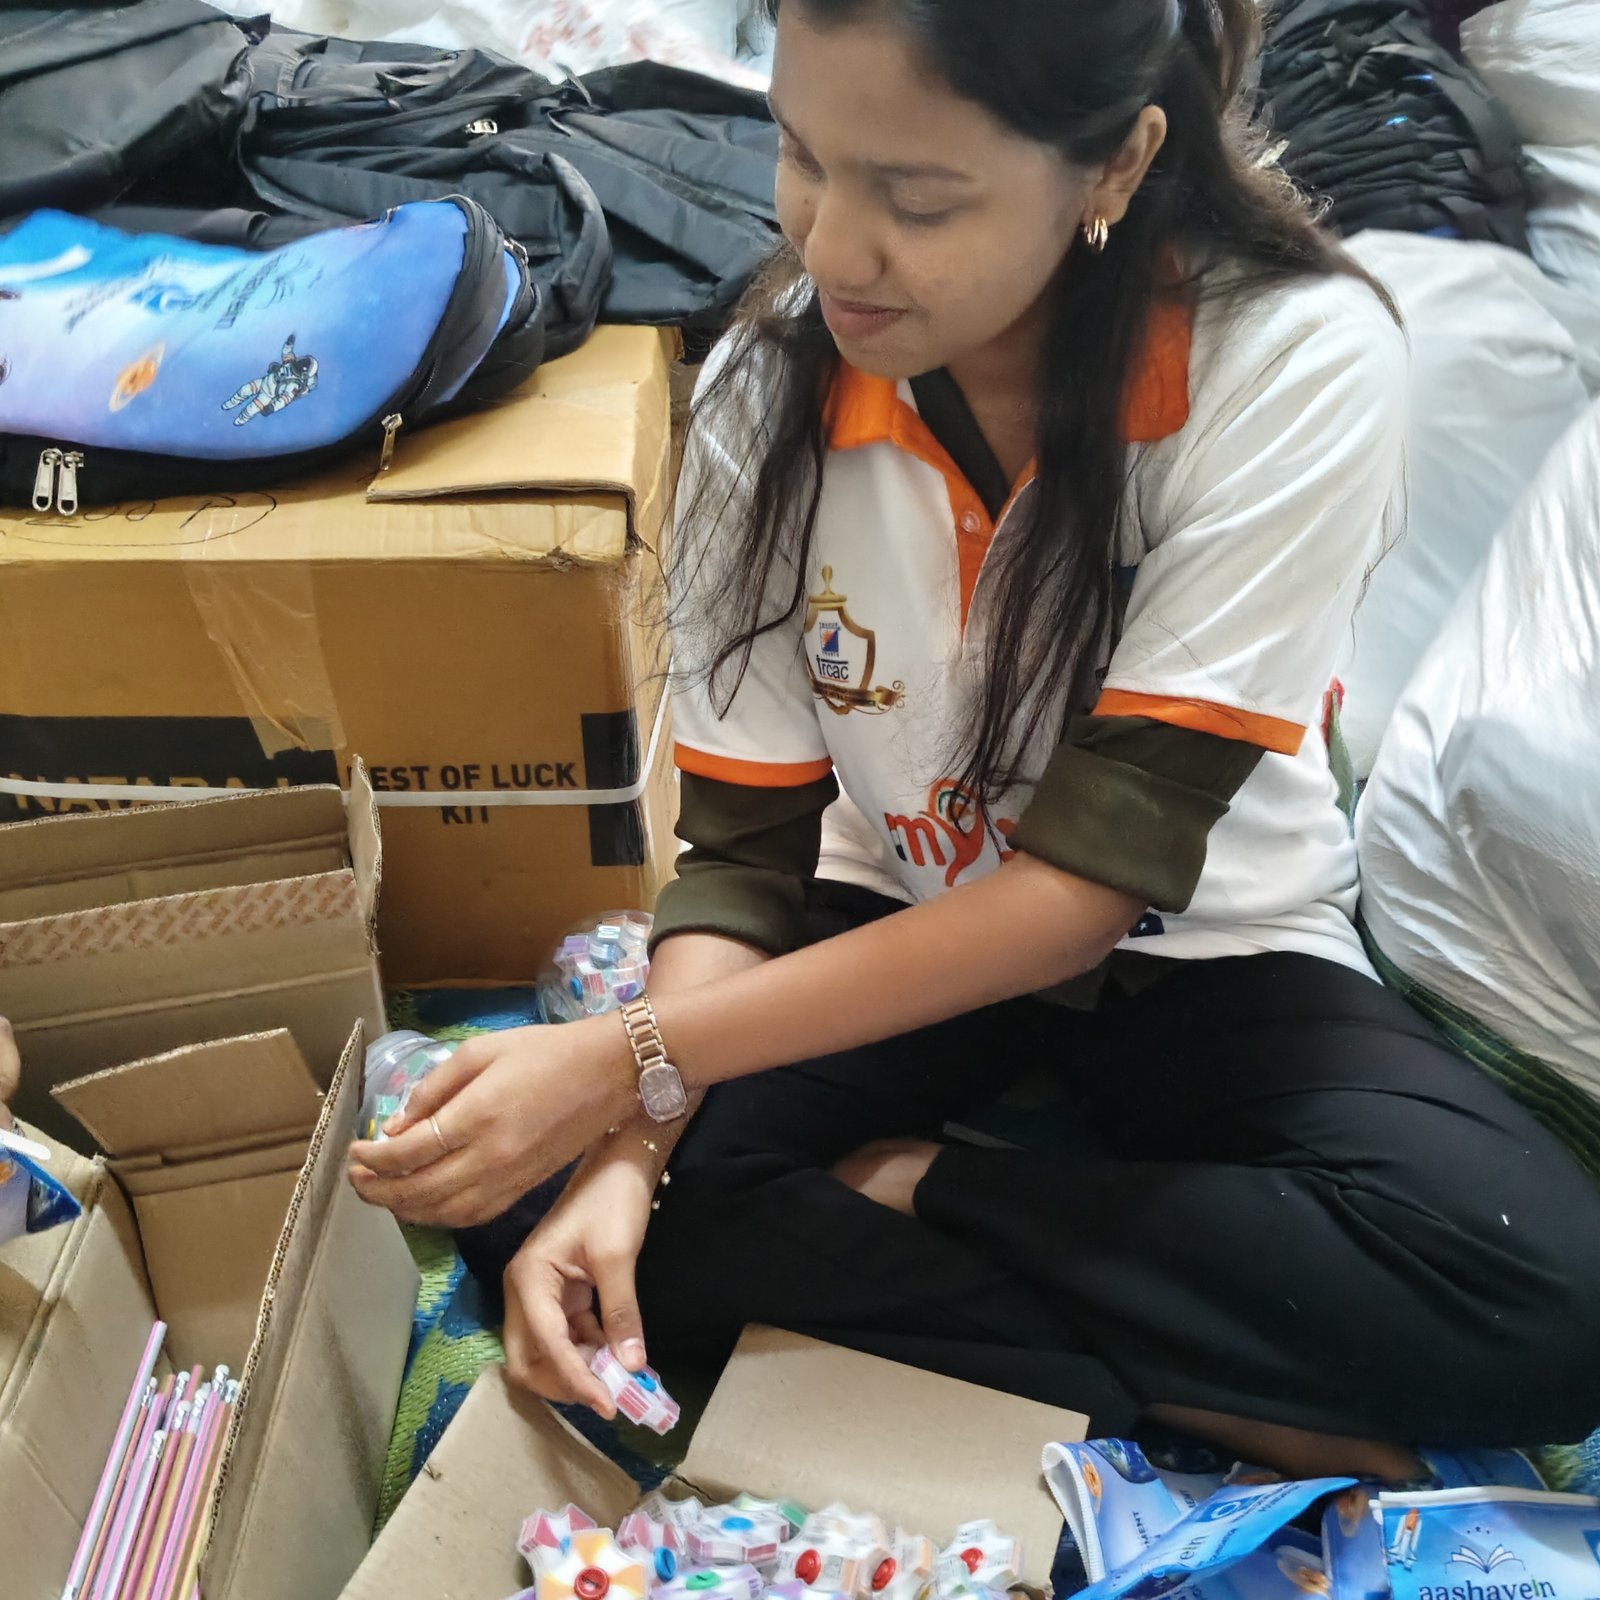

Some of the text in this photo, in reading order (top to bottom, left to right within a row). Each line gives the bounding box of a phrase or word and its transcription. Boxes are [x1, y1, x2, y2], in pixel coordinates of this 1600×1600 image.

[347, 762, 578, 792] EST OF LUCK
